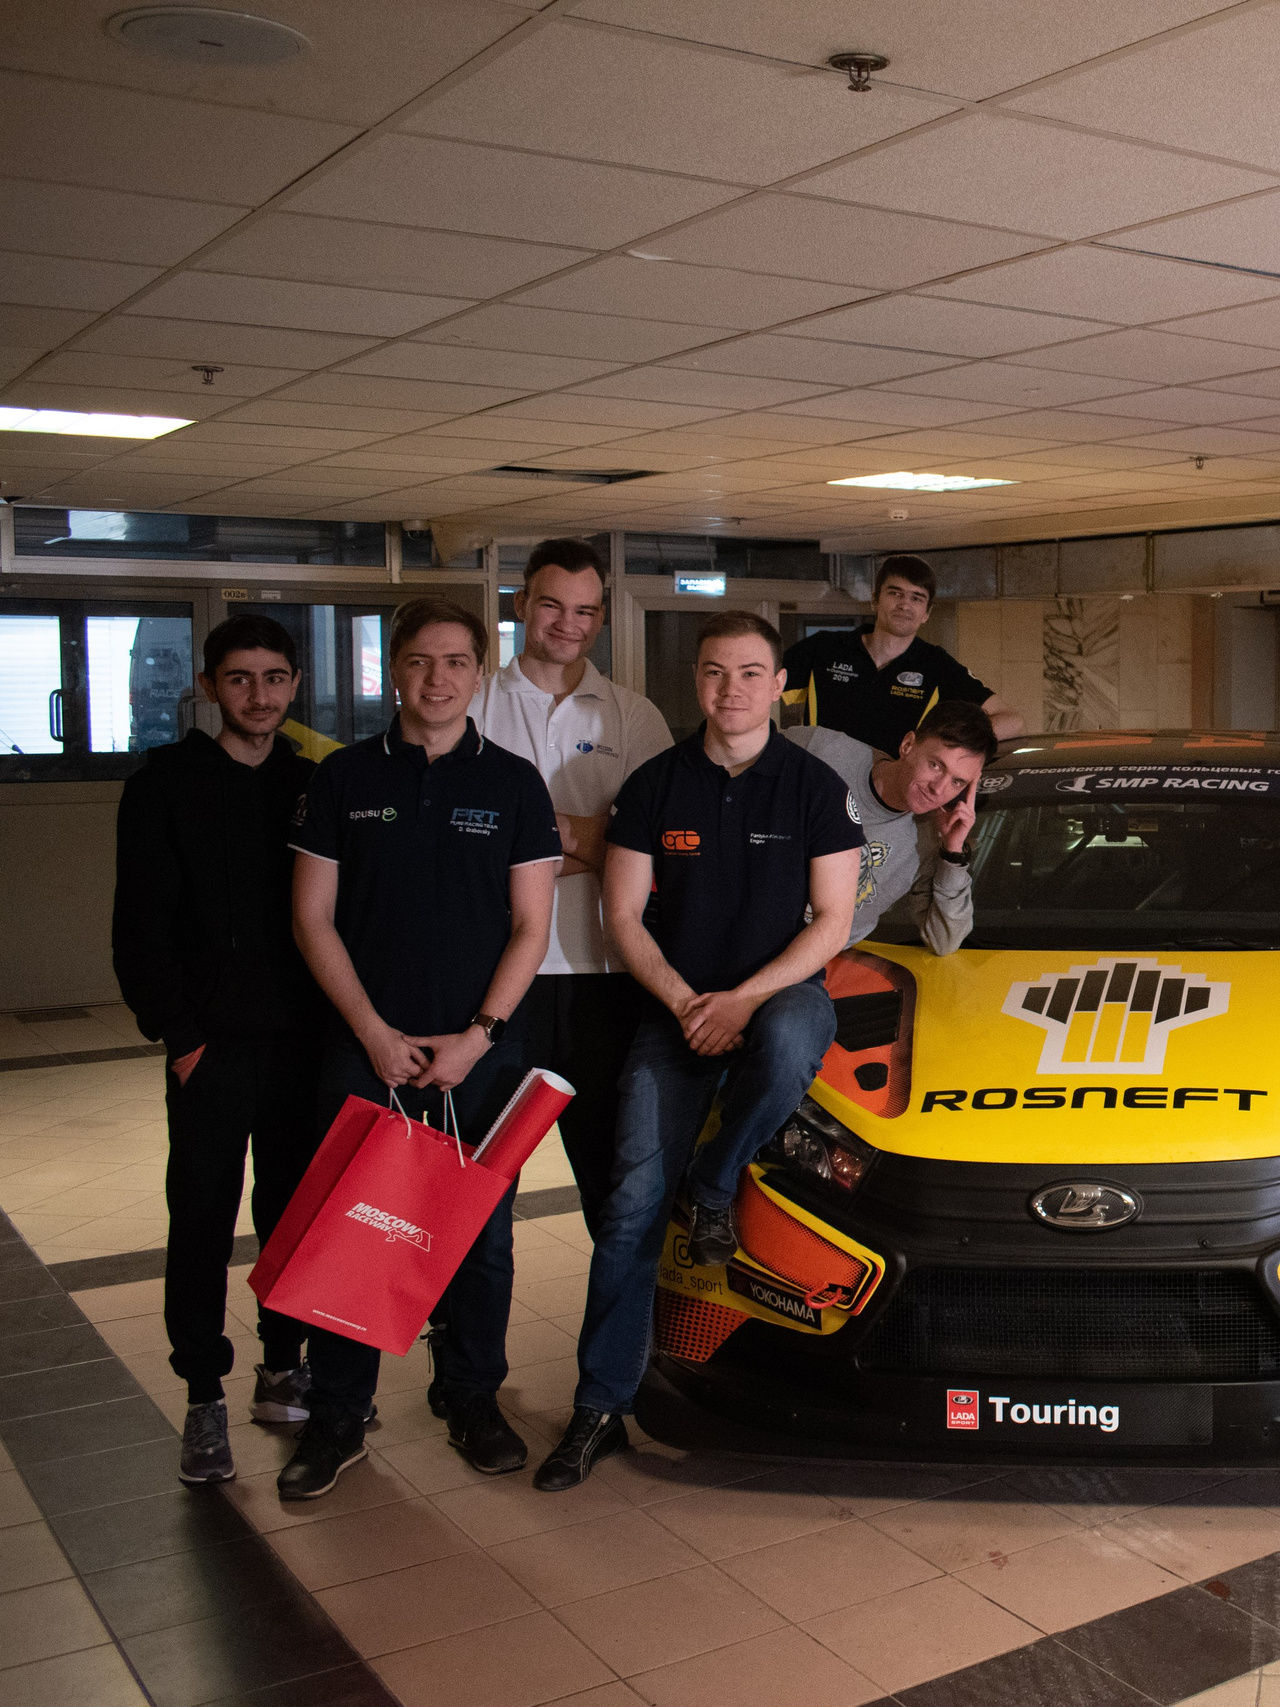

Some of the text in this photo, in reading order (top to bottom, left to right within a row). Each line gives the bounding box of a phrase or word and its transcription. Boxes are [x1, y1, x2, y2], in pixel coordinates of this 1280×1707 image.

[833, 661, 854, 672] LADA
[832, 673, 850, 683] 2019
[1018, 766, 1113, 775] Российская
[1118, 765, 1167, 773] серия
[1172, 766, 1262, 774] кольцевых
[1095, 778, 1270, 792] SMP RACING
[349, 809, 381, 821] spusu
[451, 807, 500, 824] PRT
[345, 1210, 393, 1232] RACEWAY
[351, 1202, 422, 1235] MOSCOW
[750, 1282, 816, 1323] YOKOHAMA
[951, 1412, 976, 1421] LADA
[988, 1396, 1120, 1433] Touring
